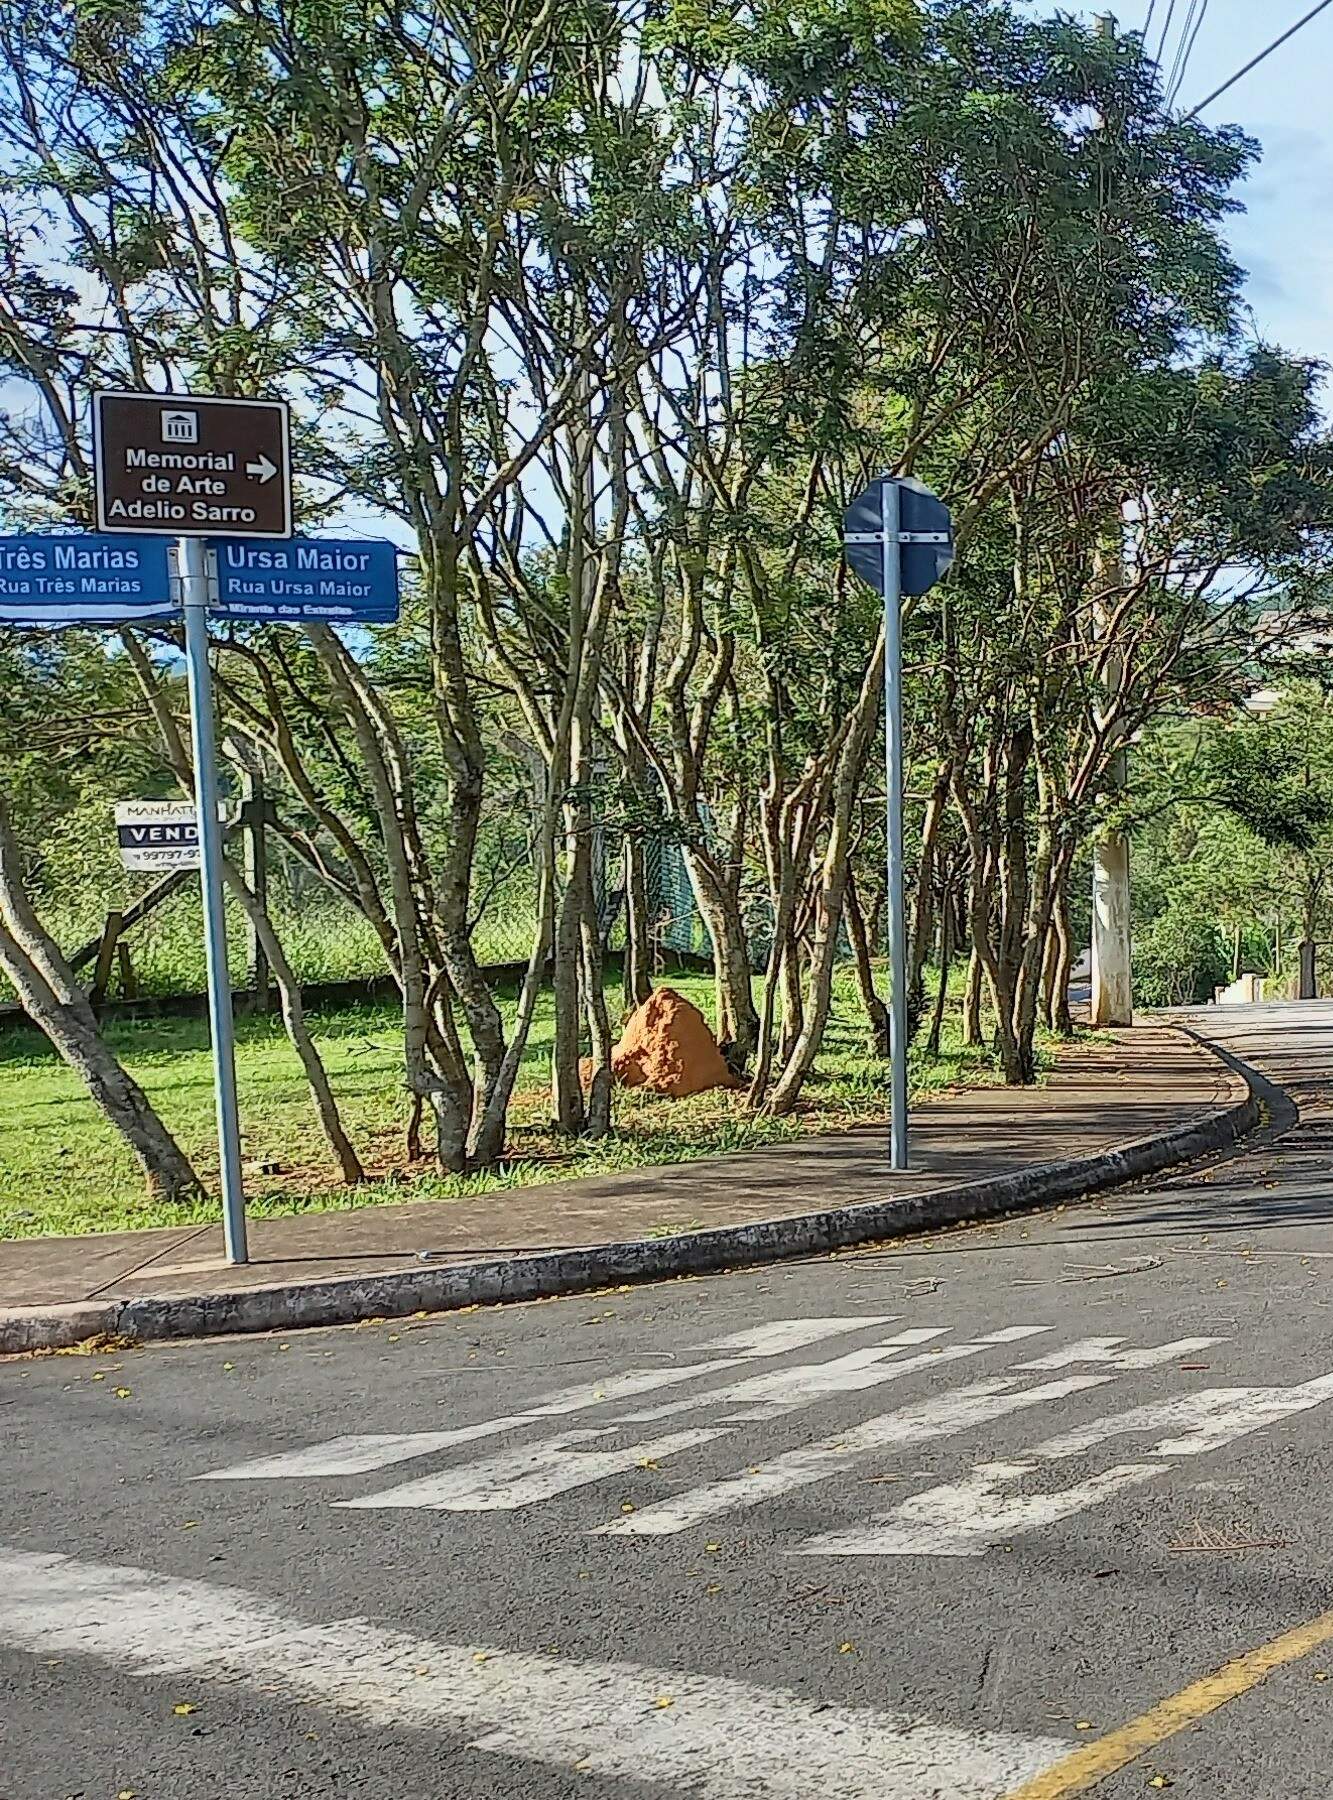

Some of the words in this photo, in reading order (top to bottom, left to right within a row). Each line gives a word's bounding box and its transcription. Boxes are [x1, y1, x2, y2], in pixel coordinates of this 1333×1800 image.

[126, 449, 235, 471] Memorial
[142, 475, 171, 493] de
[176, 475, 226, 495] Arte
[109, 499, 186, 519] Adelio
[191, 501, 256, 522] Sarro
[54, 546, 139, 569] Marias
[227, 545, 288, 569] Ursa
[297, 547, 370, 571] Maior
[0, 577, 30, 593] Rua
[35, 577, 75, 593] Três
[81, 577, 141, 593] Marias
[228, 578, 265, 594] Rua
[271, 580, 314, 595] Ursa
[319, 581, 371, 597] Maior
[277, 604, 301, 614] das
[127, 802, 196, 817] MANHATT
[130, 826, 199, 841] VEND
